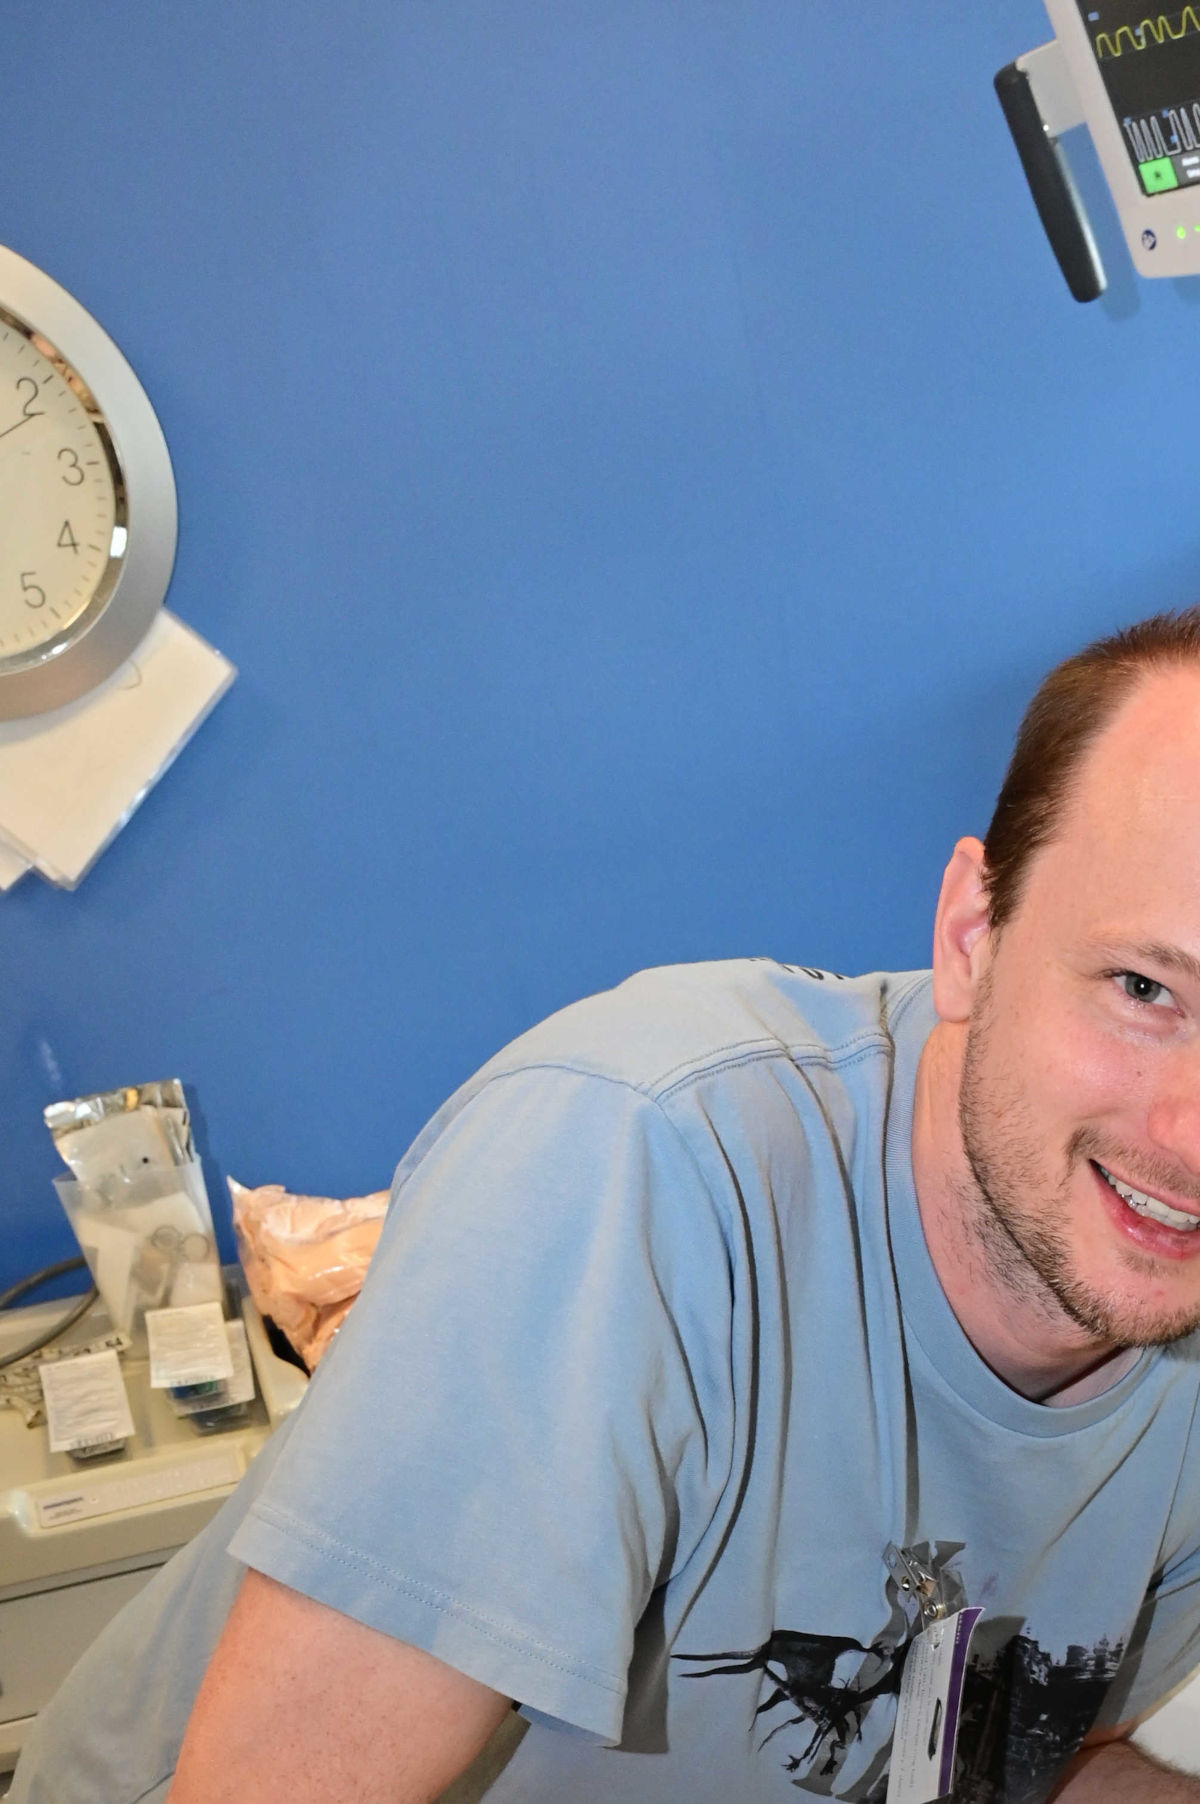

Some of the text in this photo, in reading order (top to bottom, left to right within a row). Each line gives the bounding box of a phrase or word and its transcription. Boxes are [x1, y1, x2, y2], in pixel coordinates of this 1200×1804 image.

[16, 377, 45, 417] 2
[57, 448, 85, 486] 3
[57, 520, 80, 554] 4
[20, 571, 46, 608] 5
